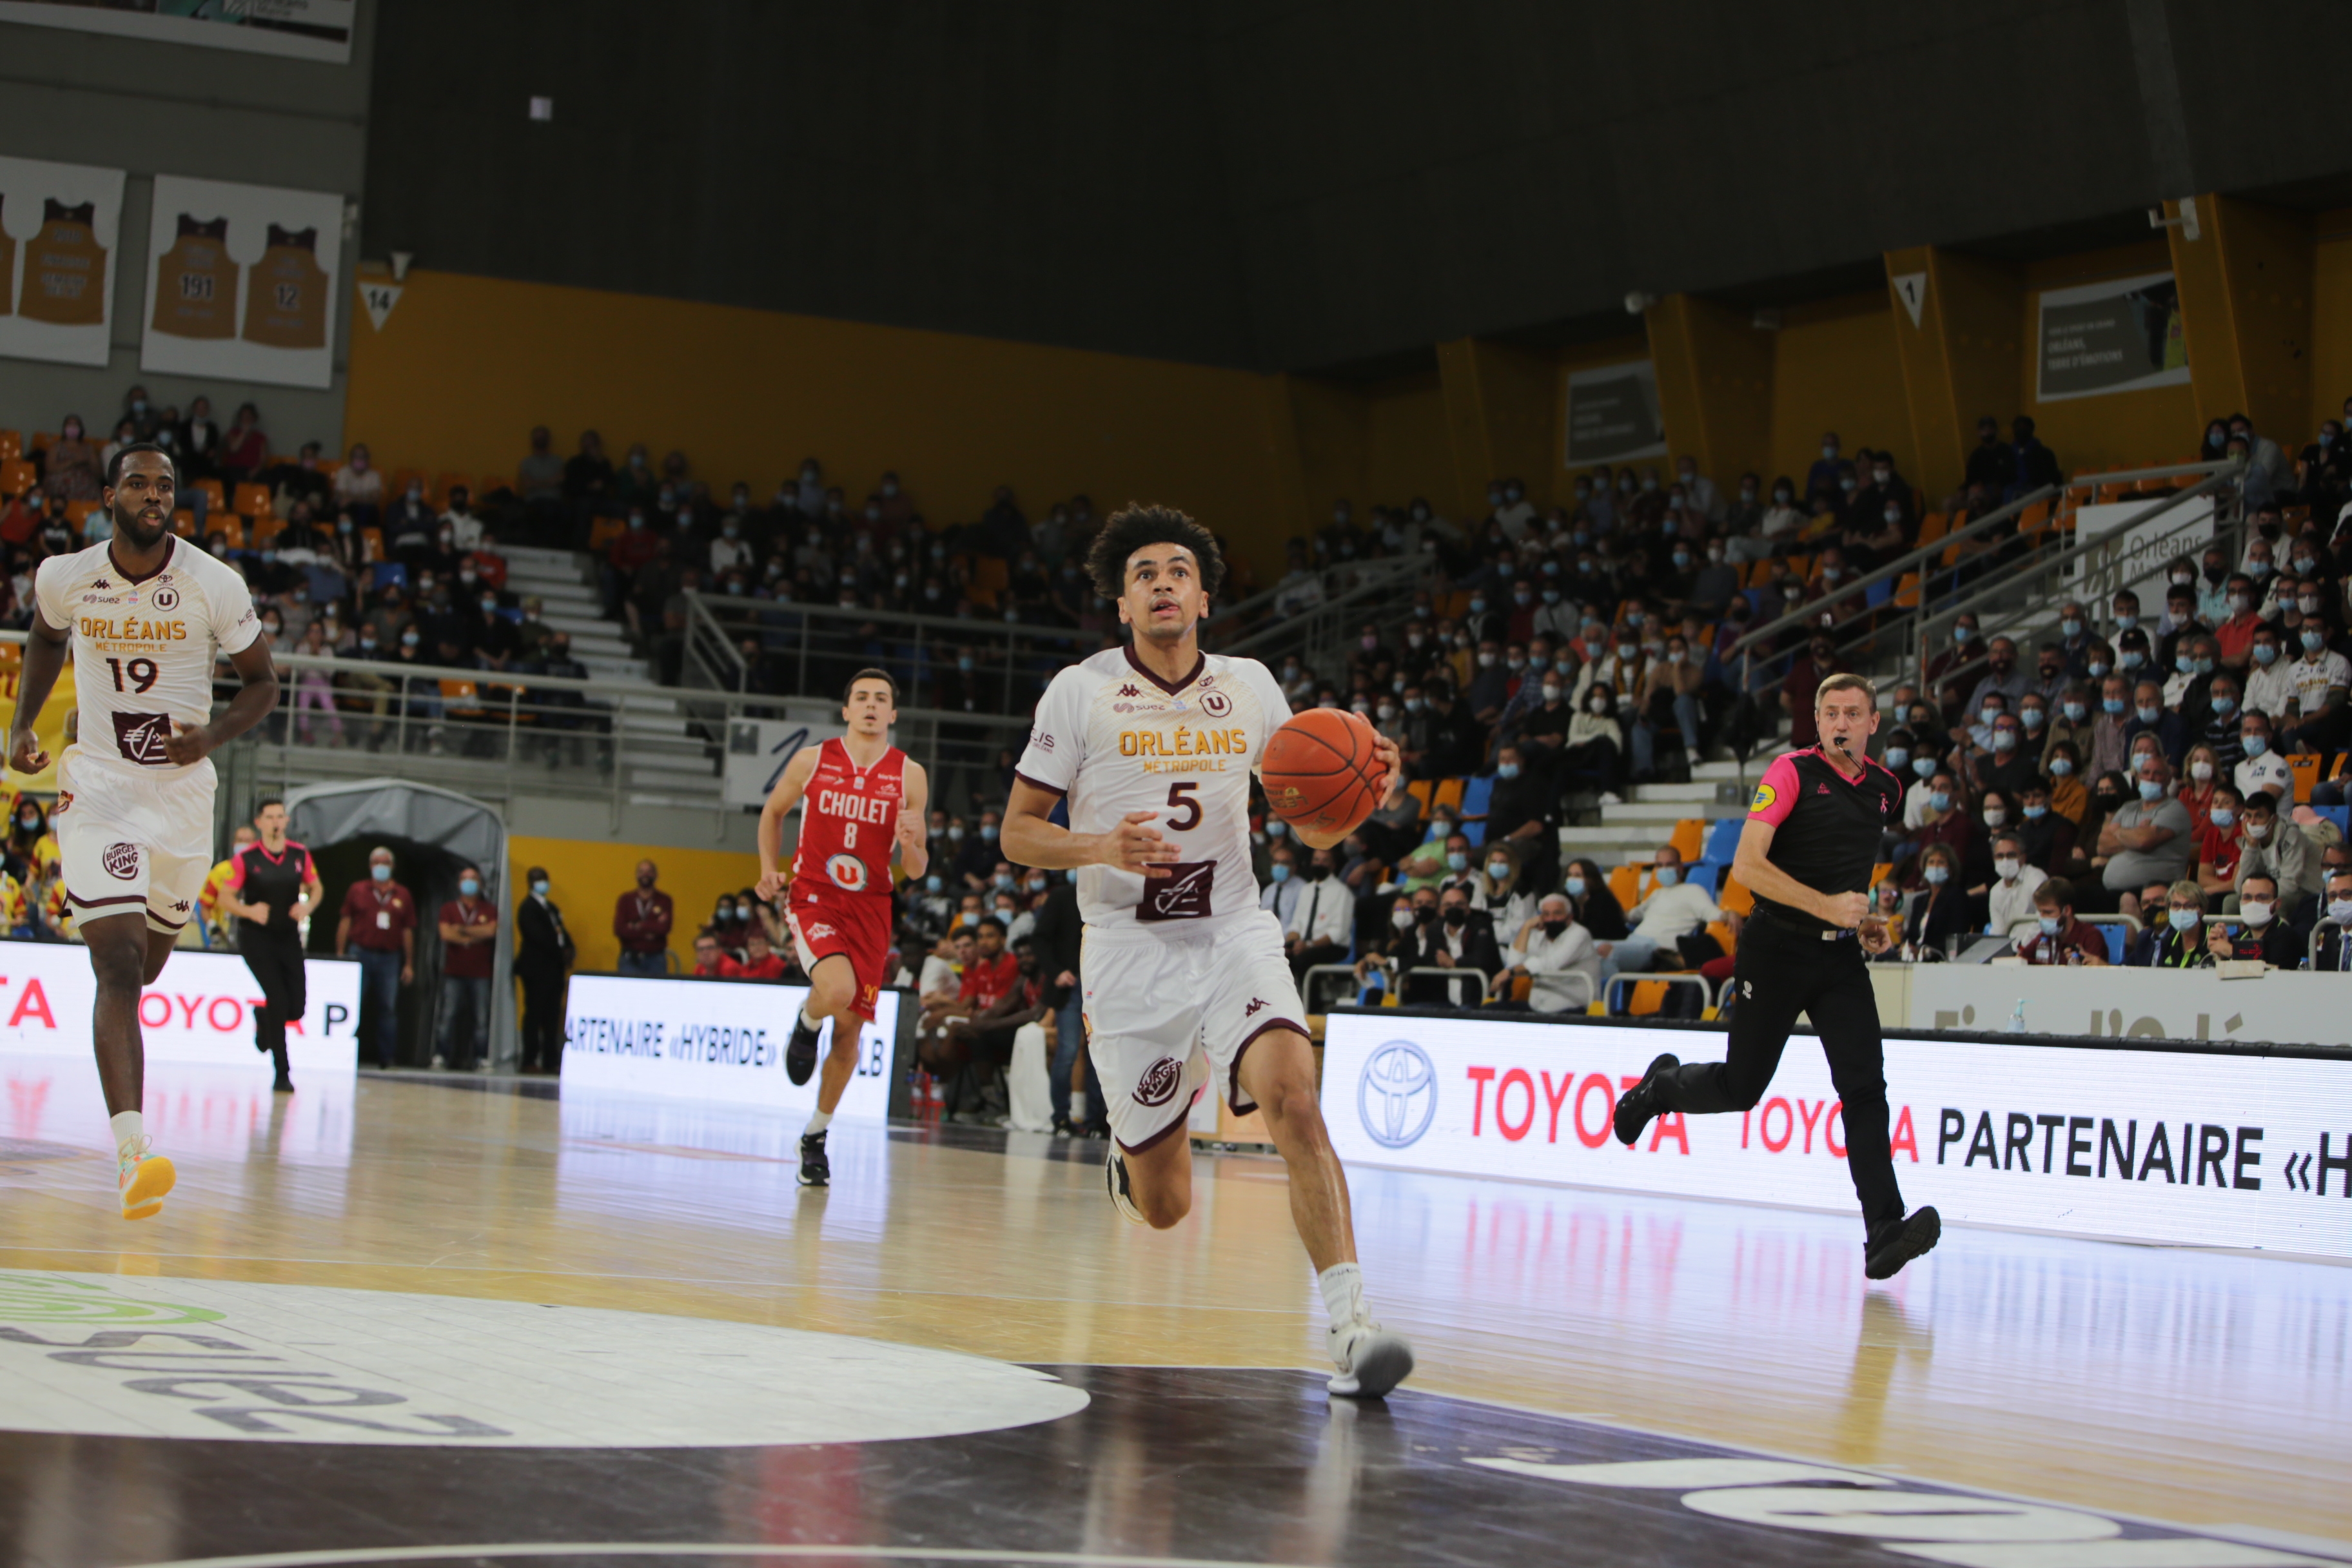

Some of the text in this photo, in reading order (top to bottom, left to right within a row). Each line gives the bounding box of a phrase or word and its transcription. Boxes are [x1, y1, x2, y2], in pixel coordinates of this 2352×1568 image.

[180, 273, 214, 300] 191
[275, 284, 299, 308] 12
[1905, 280, 1915, 305] 1
[369, 288, 390, 310] 14
[159, 593, 172, 606] U
[80, 616, 186, 640] ORLÉANS
[95, 640, 168, 652] MÉTROPOLE
[106, 658, 160, 694] 19
[1206, 696, 1225, 710] U
[1119, 725, 1248, 756] ORLÉANS
[1142, 758, 1227, 773] MÉTROPOLE
[818, 789, 890, 825] CHOLET
[1166, 782, 1203, 832] 5
[843, 821, 858, 850] 8
[106, 844, 137, 861] BURGER
[109, 852, 139, 872] KING
[836, 861, 858, 885] U
[1739, 1092, 1919, 1163] TOYOA
[1938, 1108, 2264, 1191] PARTENAIRE
